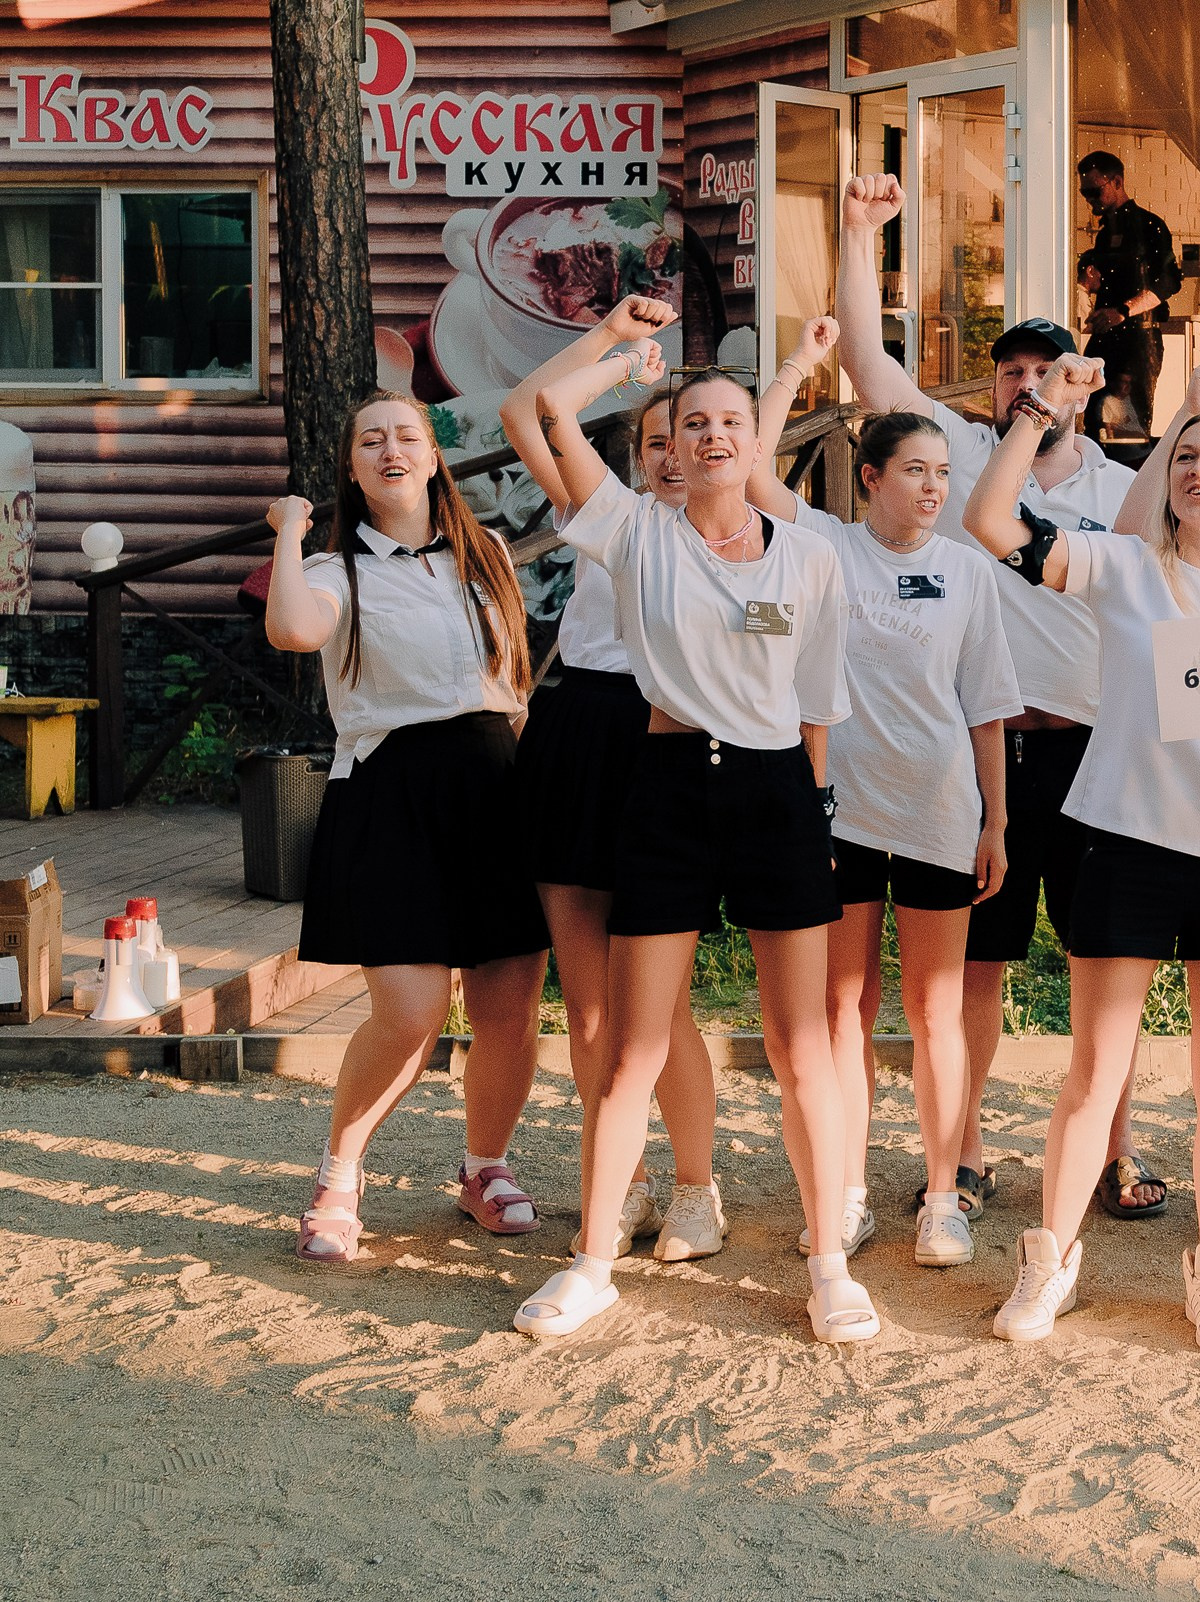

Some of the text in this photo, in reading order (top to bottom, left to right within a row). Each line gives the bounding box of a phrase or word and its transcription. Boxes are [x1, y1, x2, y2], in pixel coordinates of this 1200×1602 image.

[17, 73, 208, 146] Квас
[464, 161, 649, 194] кухня
[701, 156, 755, 200] Рады
[856, 590, 923, 617] IVIERA
[1184, 668, 1200, 689] 6
